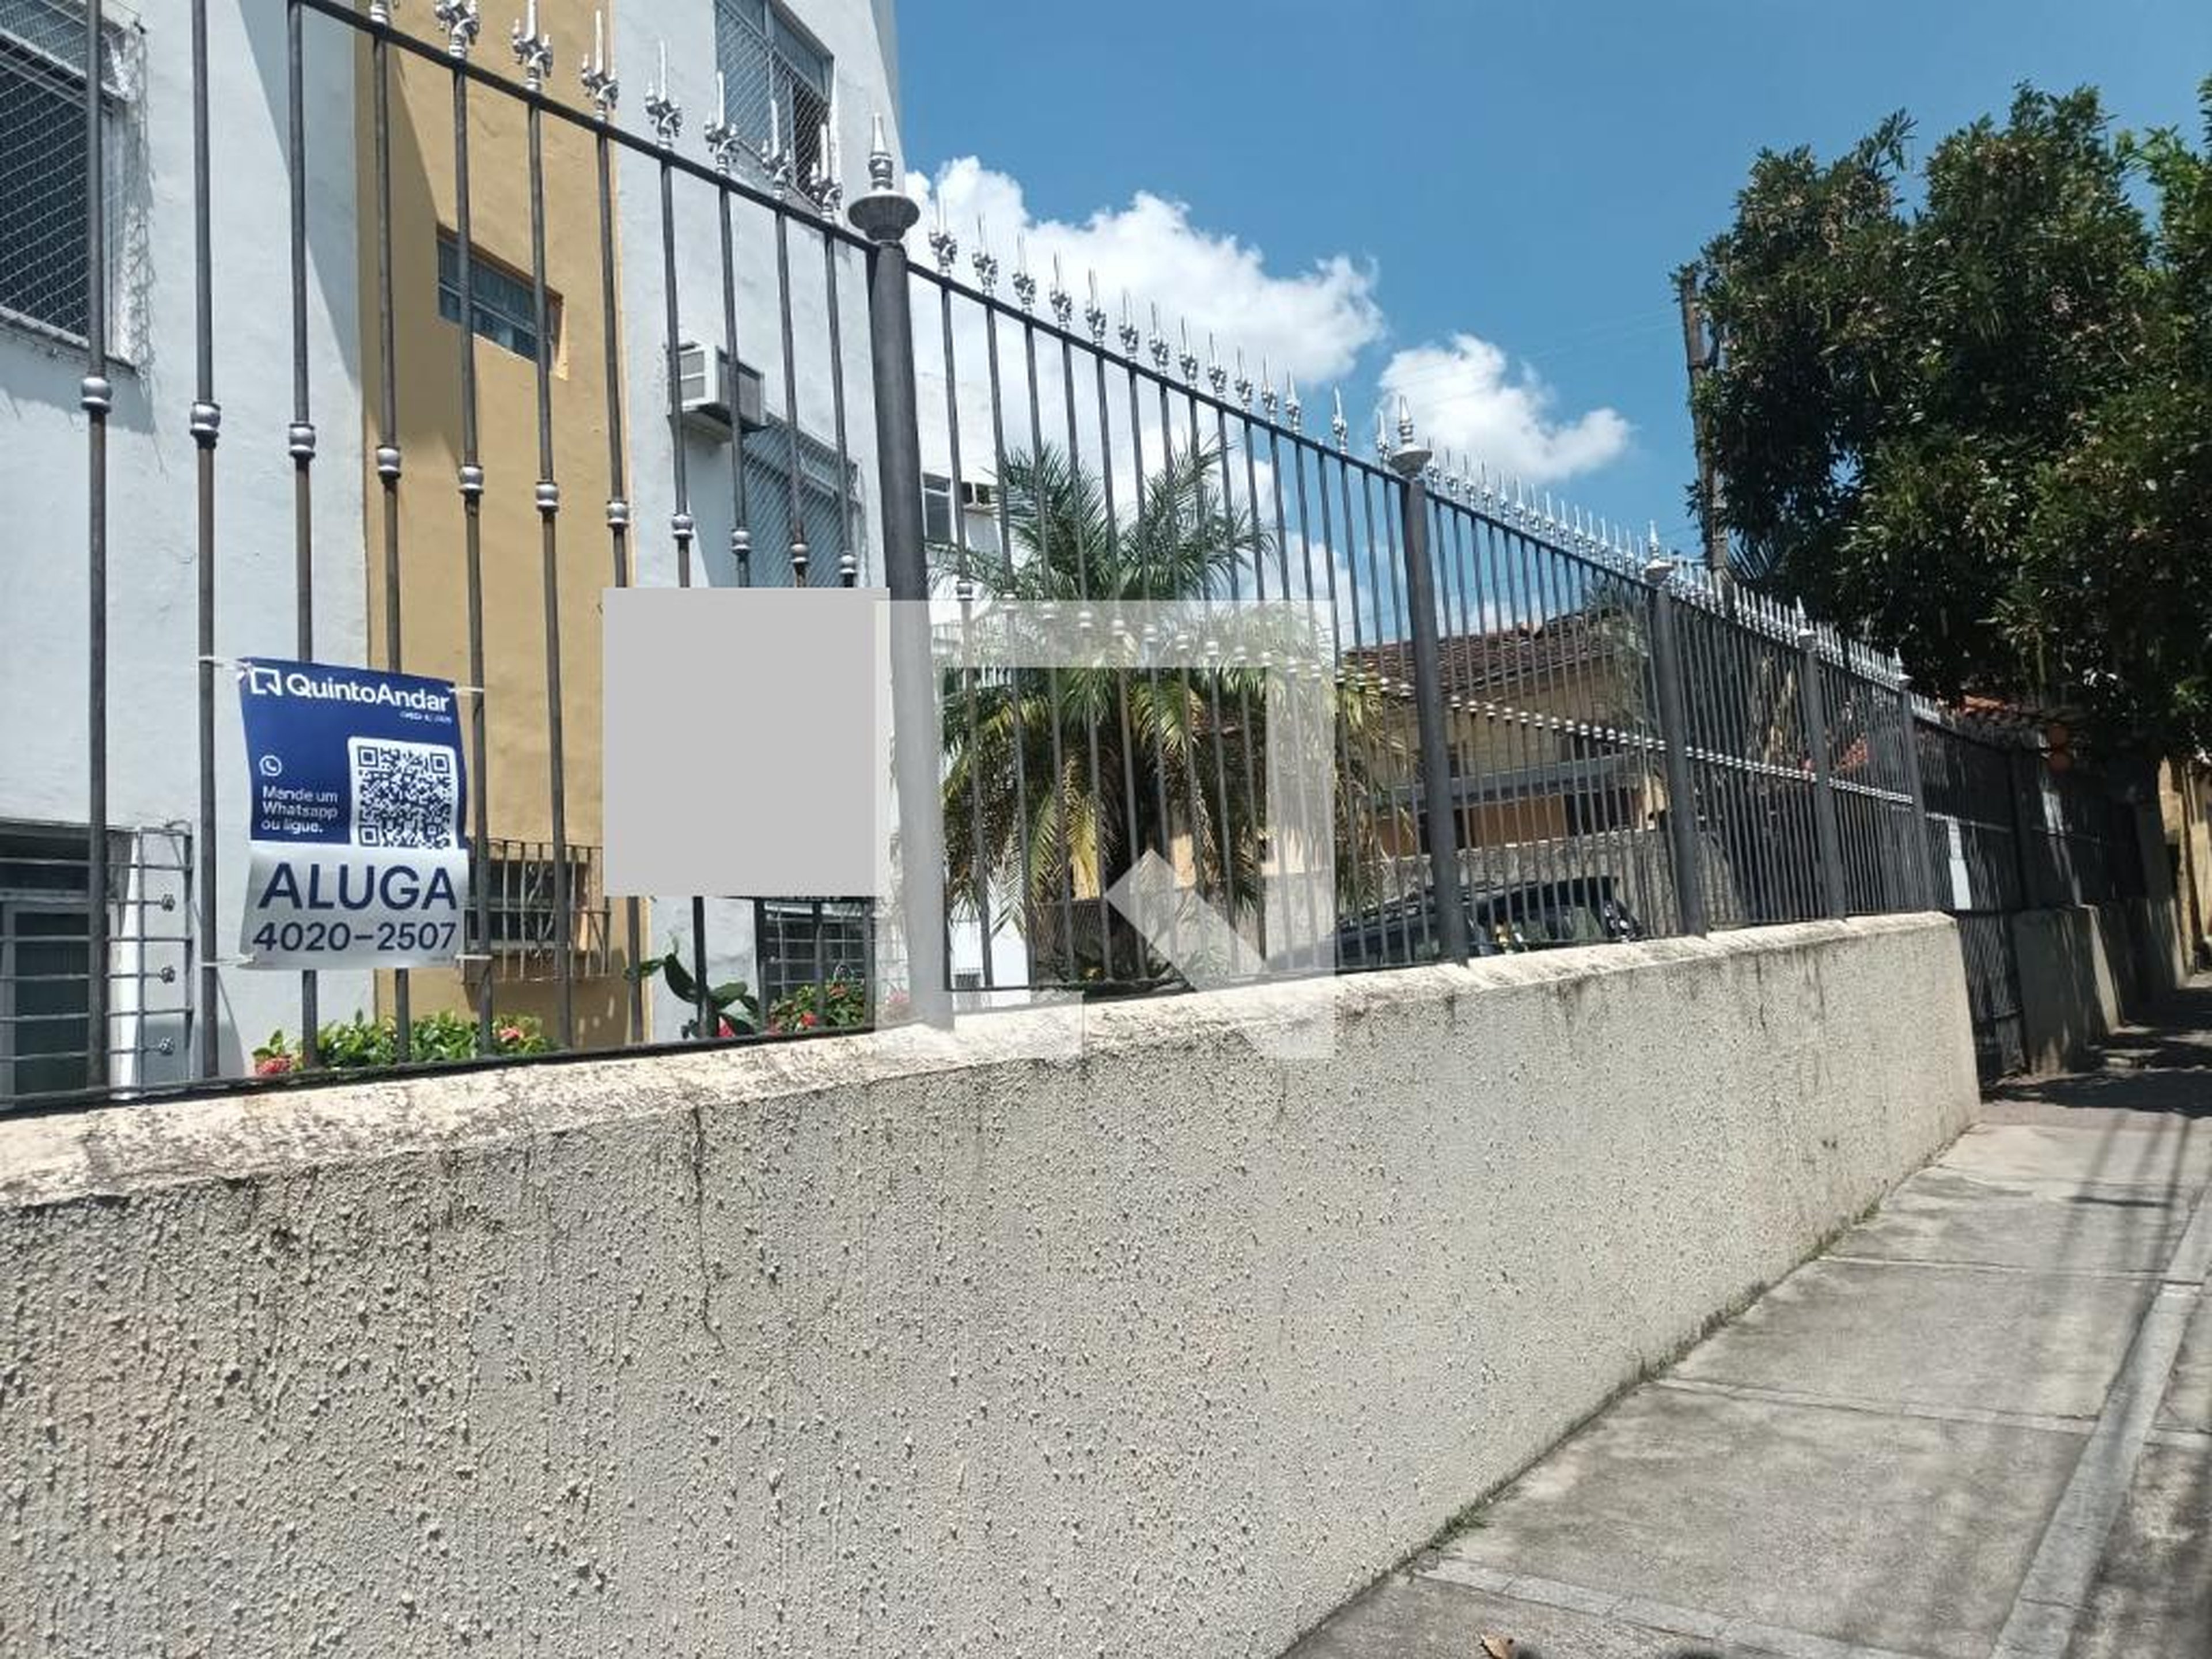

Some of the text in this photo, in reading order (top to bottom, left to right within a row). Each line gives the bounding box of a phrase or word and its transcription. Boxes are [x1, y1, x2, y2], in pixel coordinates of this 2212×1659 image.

[287, 672, 450, 712] QuintoAndar
[263, 785, 338, 802] Mande um
[262, 801, 338, 820] Whatsapp
[260, 819, 280, 830] ou
[257, 862, 457, 910] ALUGA
[252, 922, 457, 952] 4020-2507
